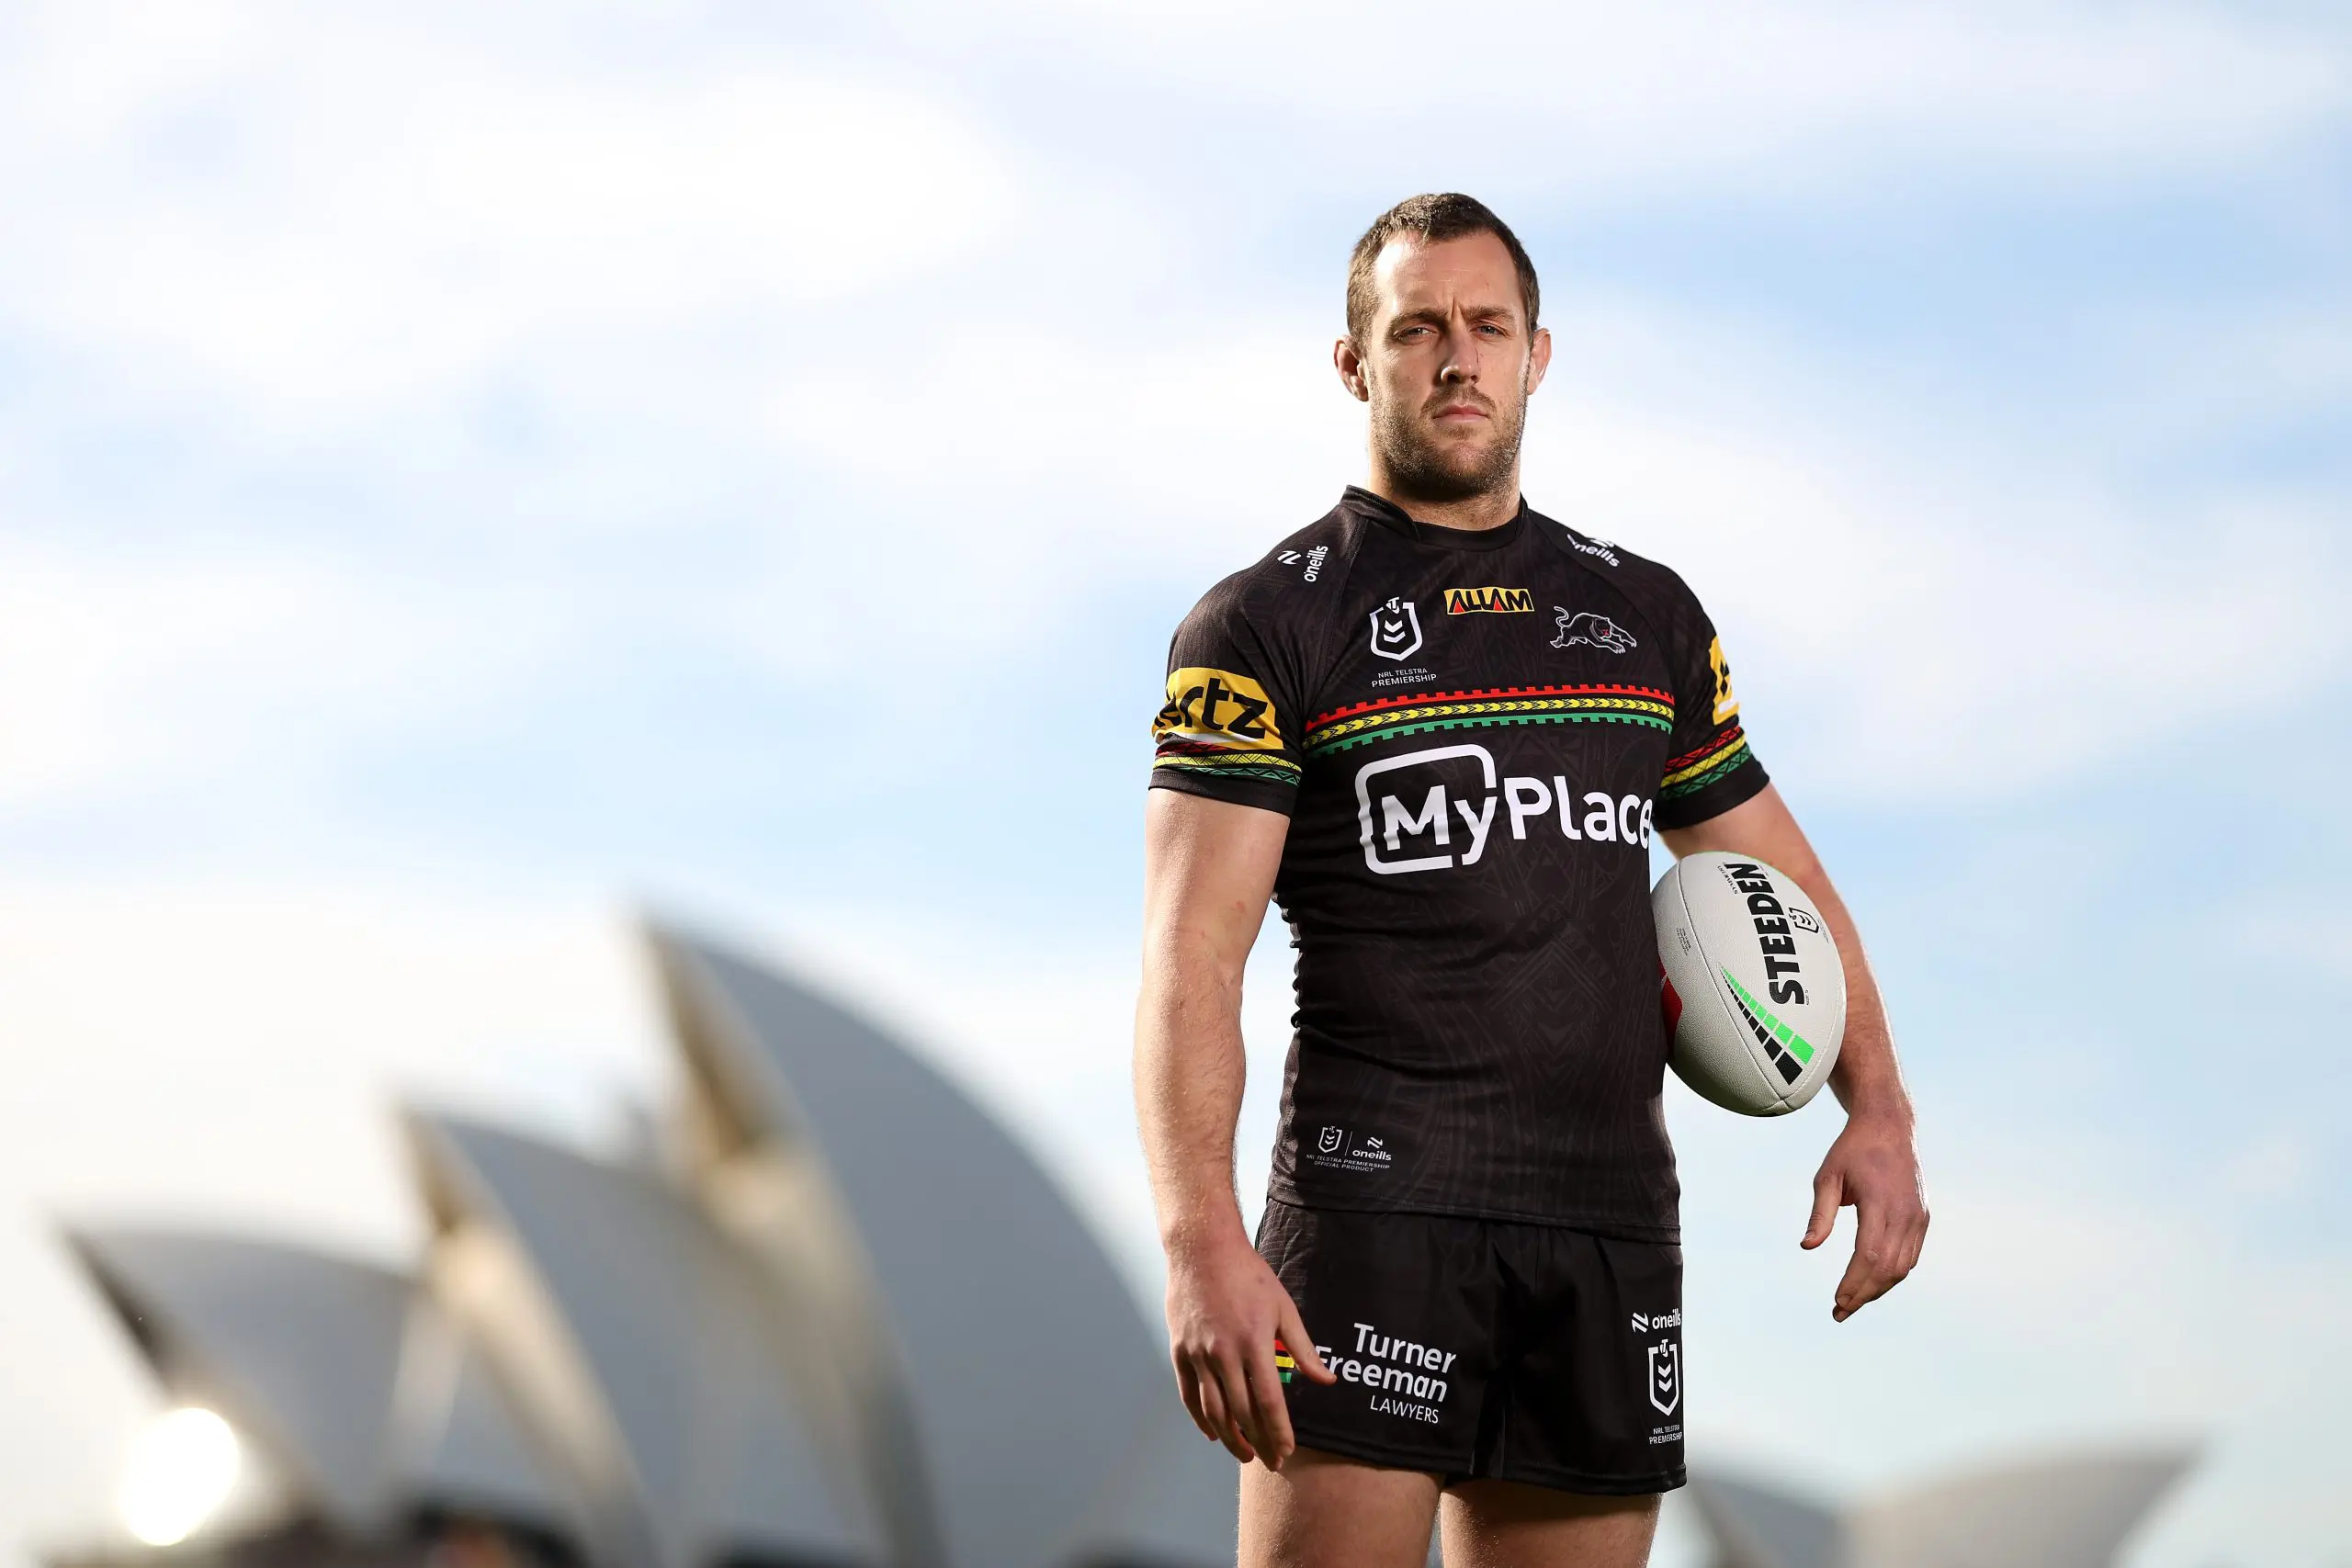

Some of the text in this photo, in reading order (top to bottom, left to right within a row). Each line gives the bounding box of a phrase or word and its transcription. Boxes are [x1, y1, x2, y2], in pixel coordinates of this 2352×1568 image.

[1448, 589, 1533, 613] ALLAM
[1371, 673, 1437, 688] PREMIERSHIP
[1378, 668, 1428, 679] NRL TELSTRA
[1381, 774, 1653, 866] MyPlace
[1724, 863, 1804, 1005] STEEDEN
[1314, 1160, 1374, 1172] OFFICIAL PRODUCT
[1317, 1155, 1341, 1163] TELSTRA
[1343, 1158, 1390, 1169] PREMIERSHIP
[1353, 1323, 1457, 1373] Turner
[1370, 1395, 1440, 1424] LAWYERS
[1654, 1427, 1664, 1435] NRL
